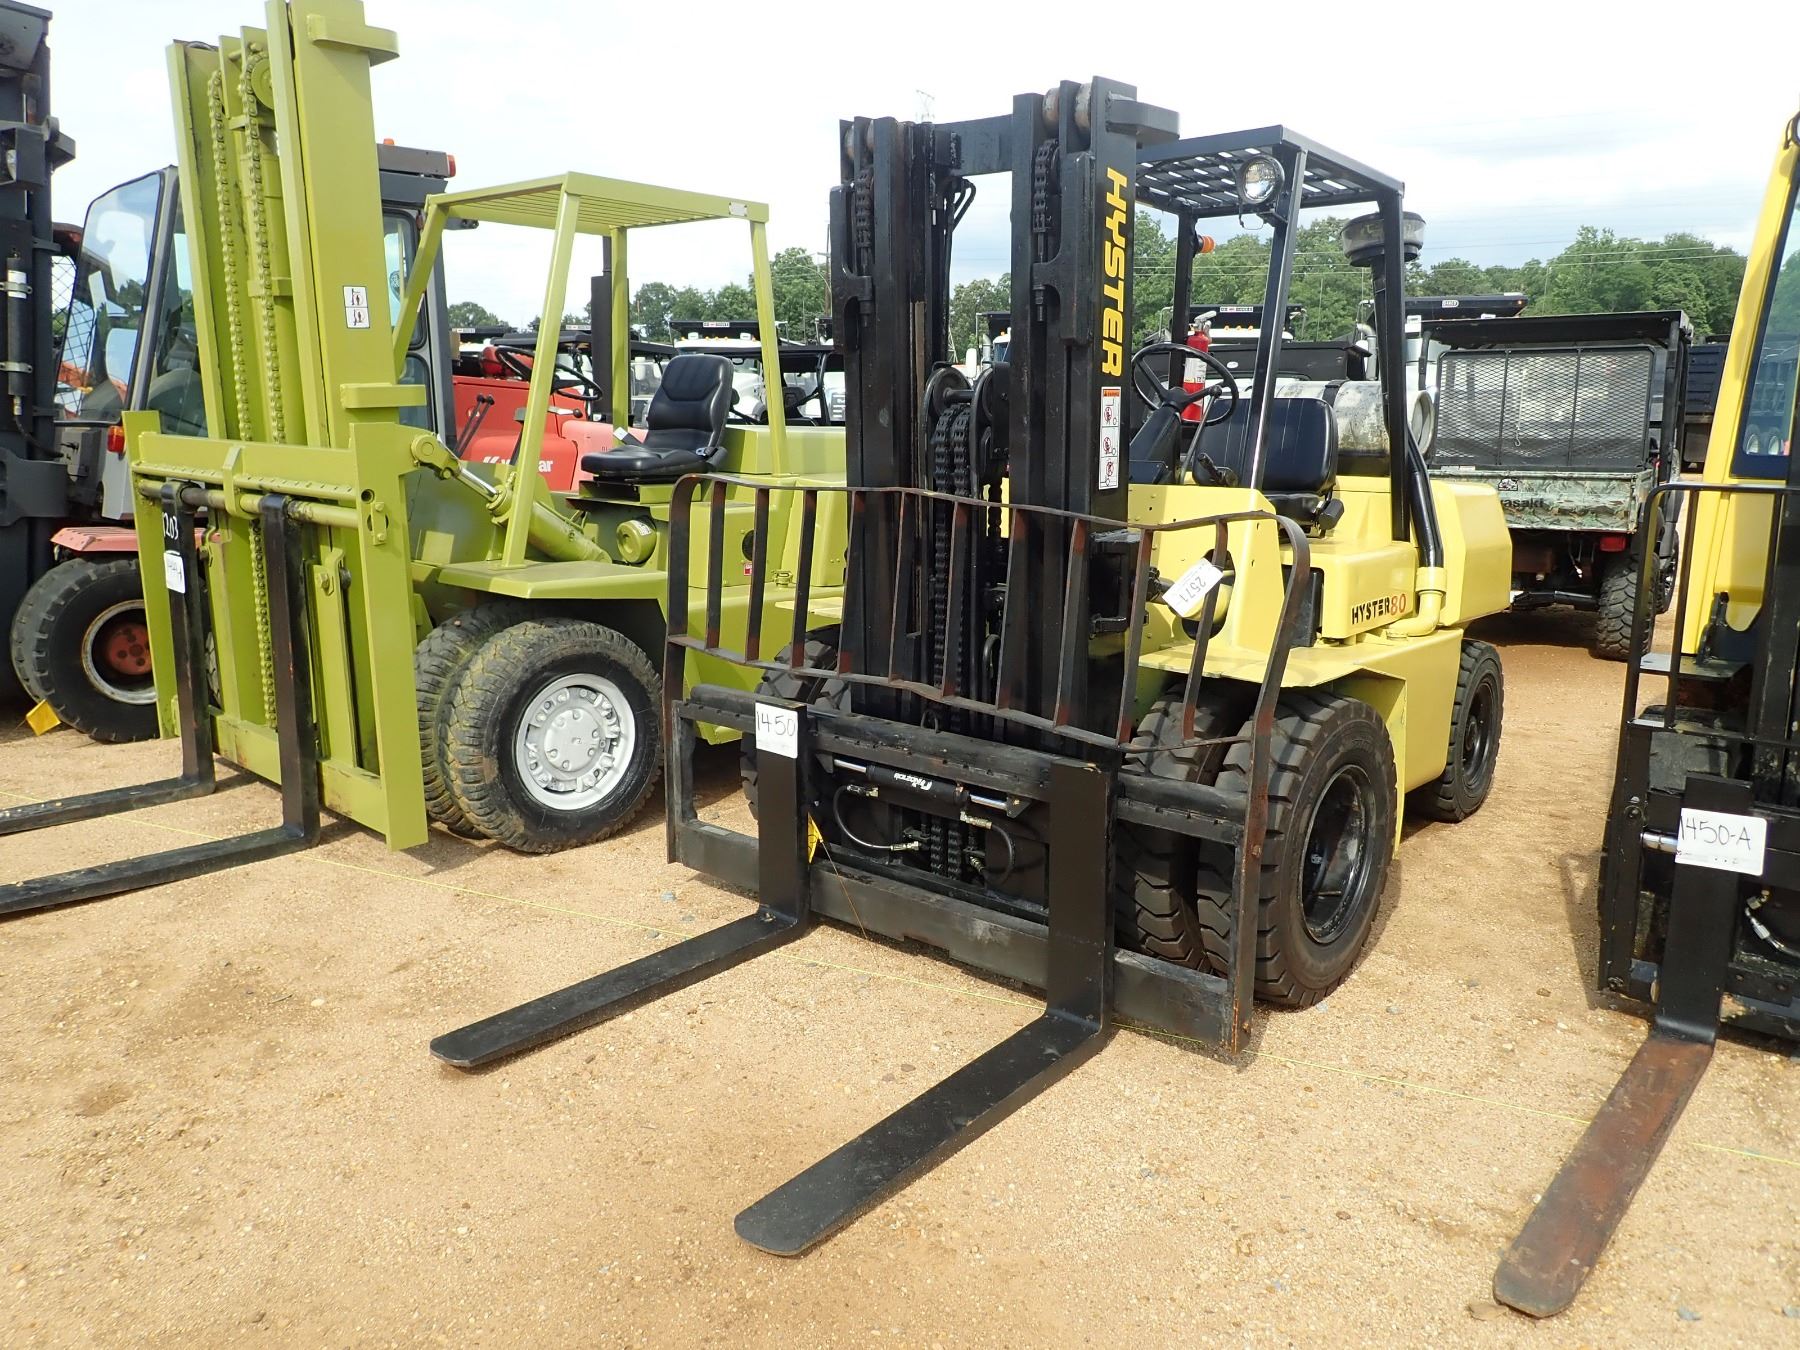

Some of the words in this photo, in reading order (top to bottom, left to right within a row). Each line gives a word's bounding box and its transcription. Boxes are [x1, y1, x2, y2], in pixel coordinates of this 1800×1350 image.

[1101, 167, 1127, 377] HYSTER
[1179, 576, 1206, 603] 2571
[756, 711, 796, 736] 1450
[1680, 815, 1751, 851] 1450-A
